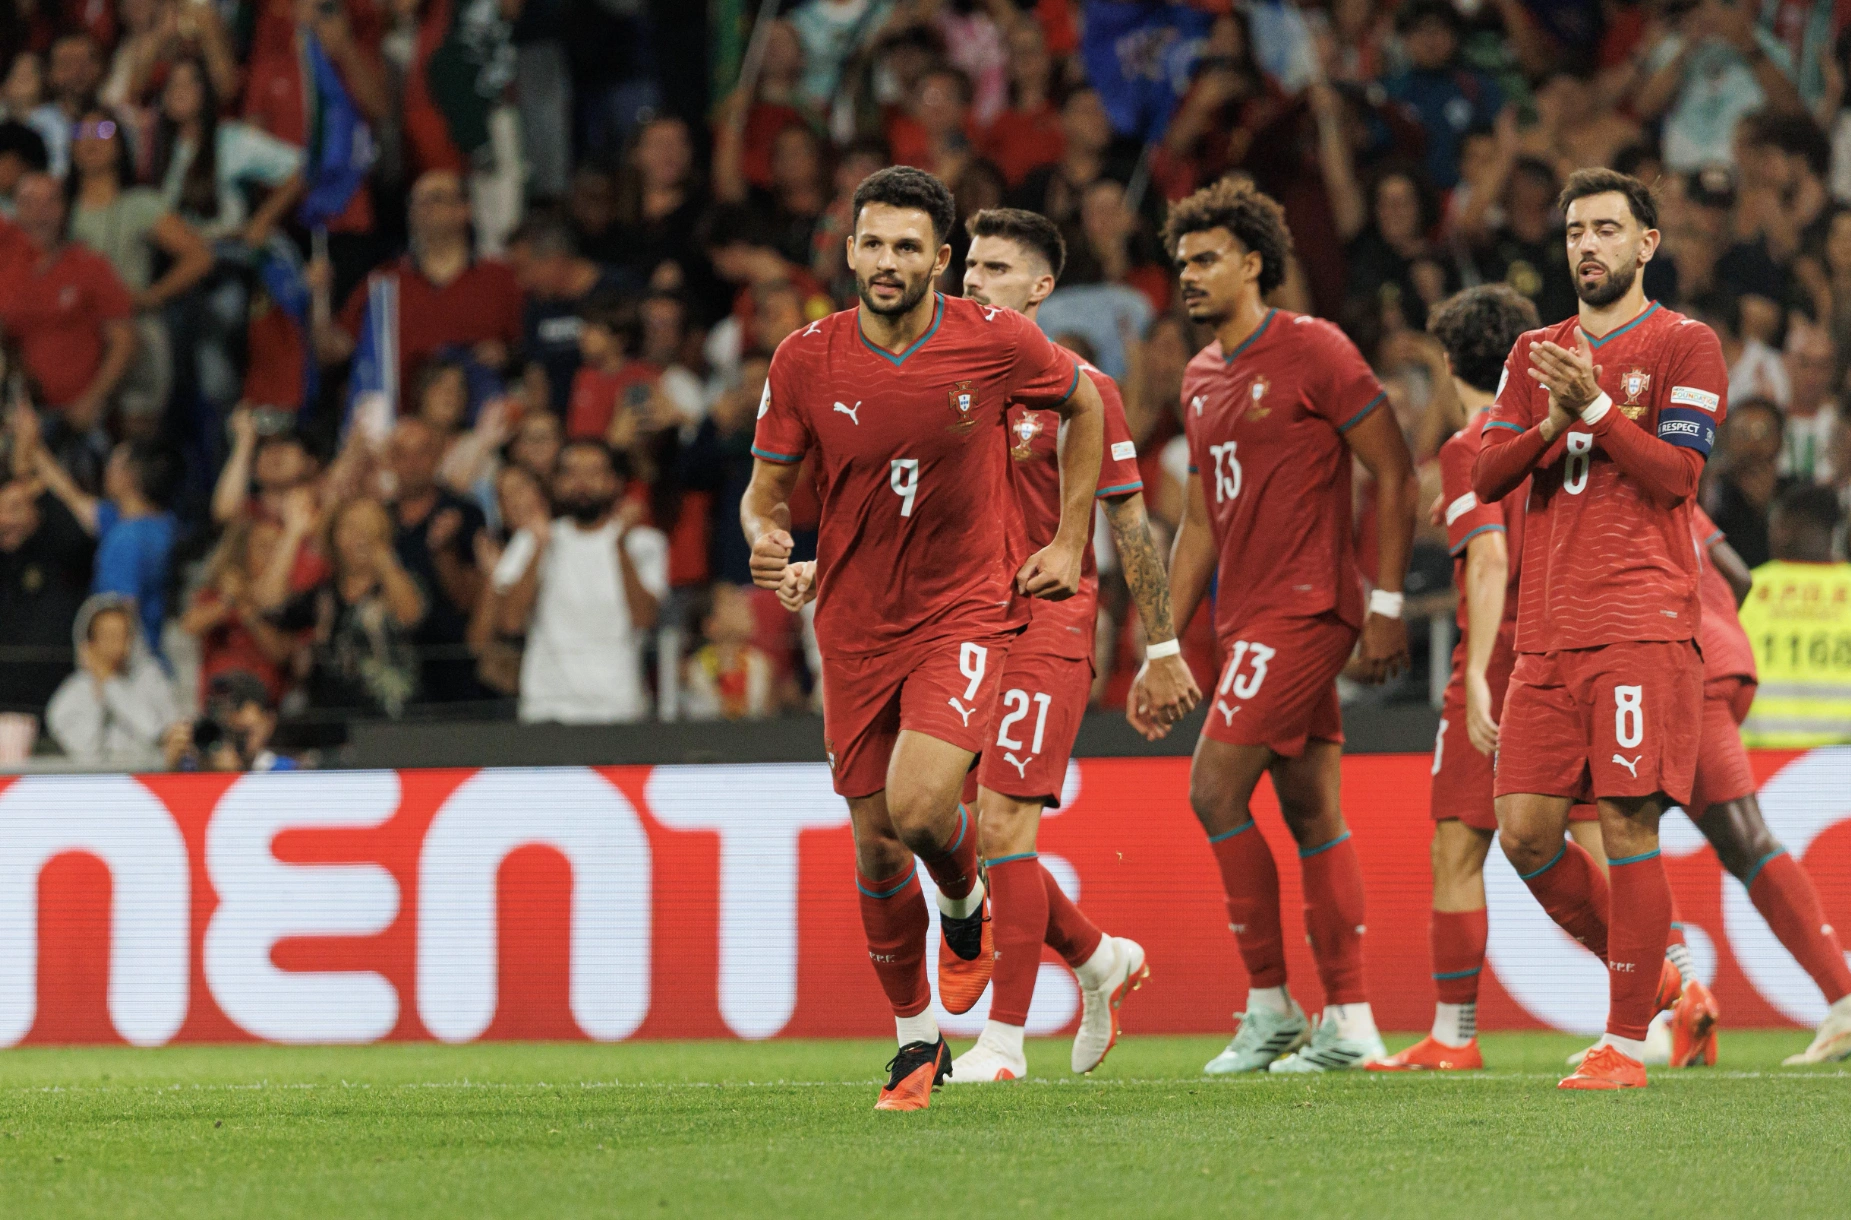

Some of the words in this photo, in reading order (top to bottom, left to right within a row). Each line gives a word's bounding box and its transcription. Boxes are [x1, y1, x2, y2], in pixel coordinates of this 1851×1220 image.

[1662, 422, 1699, 434] RESPECT
[890, 458, 919, 518] 9
[1209, 440, 1243, 503] 13
[1563, 431, 1594, 495] 8
[959, 642, 988, 701] 9
[1220, 639, 1276, 700] 13
[996, 688, 1052, 754] 21
[1614, 684, 1644, 749] 8
